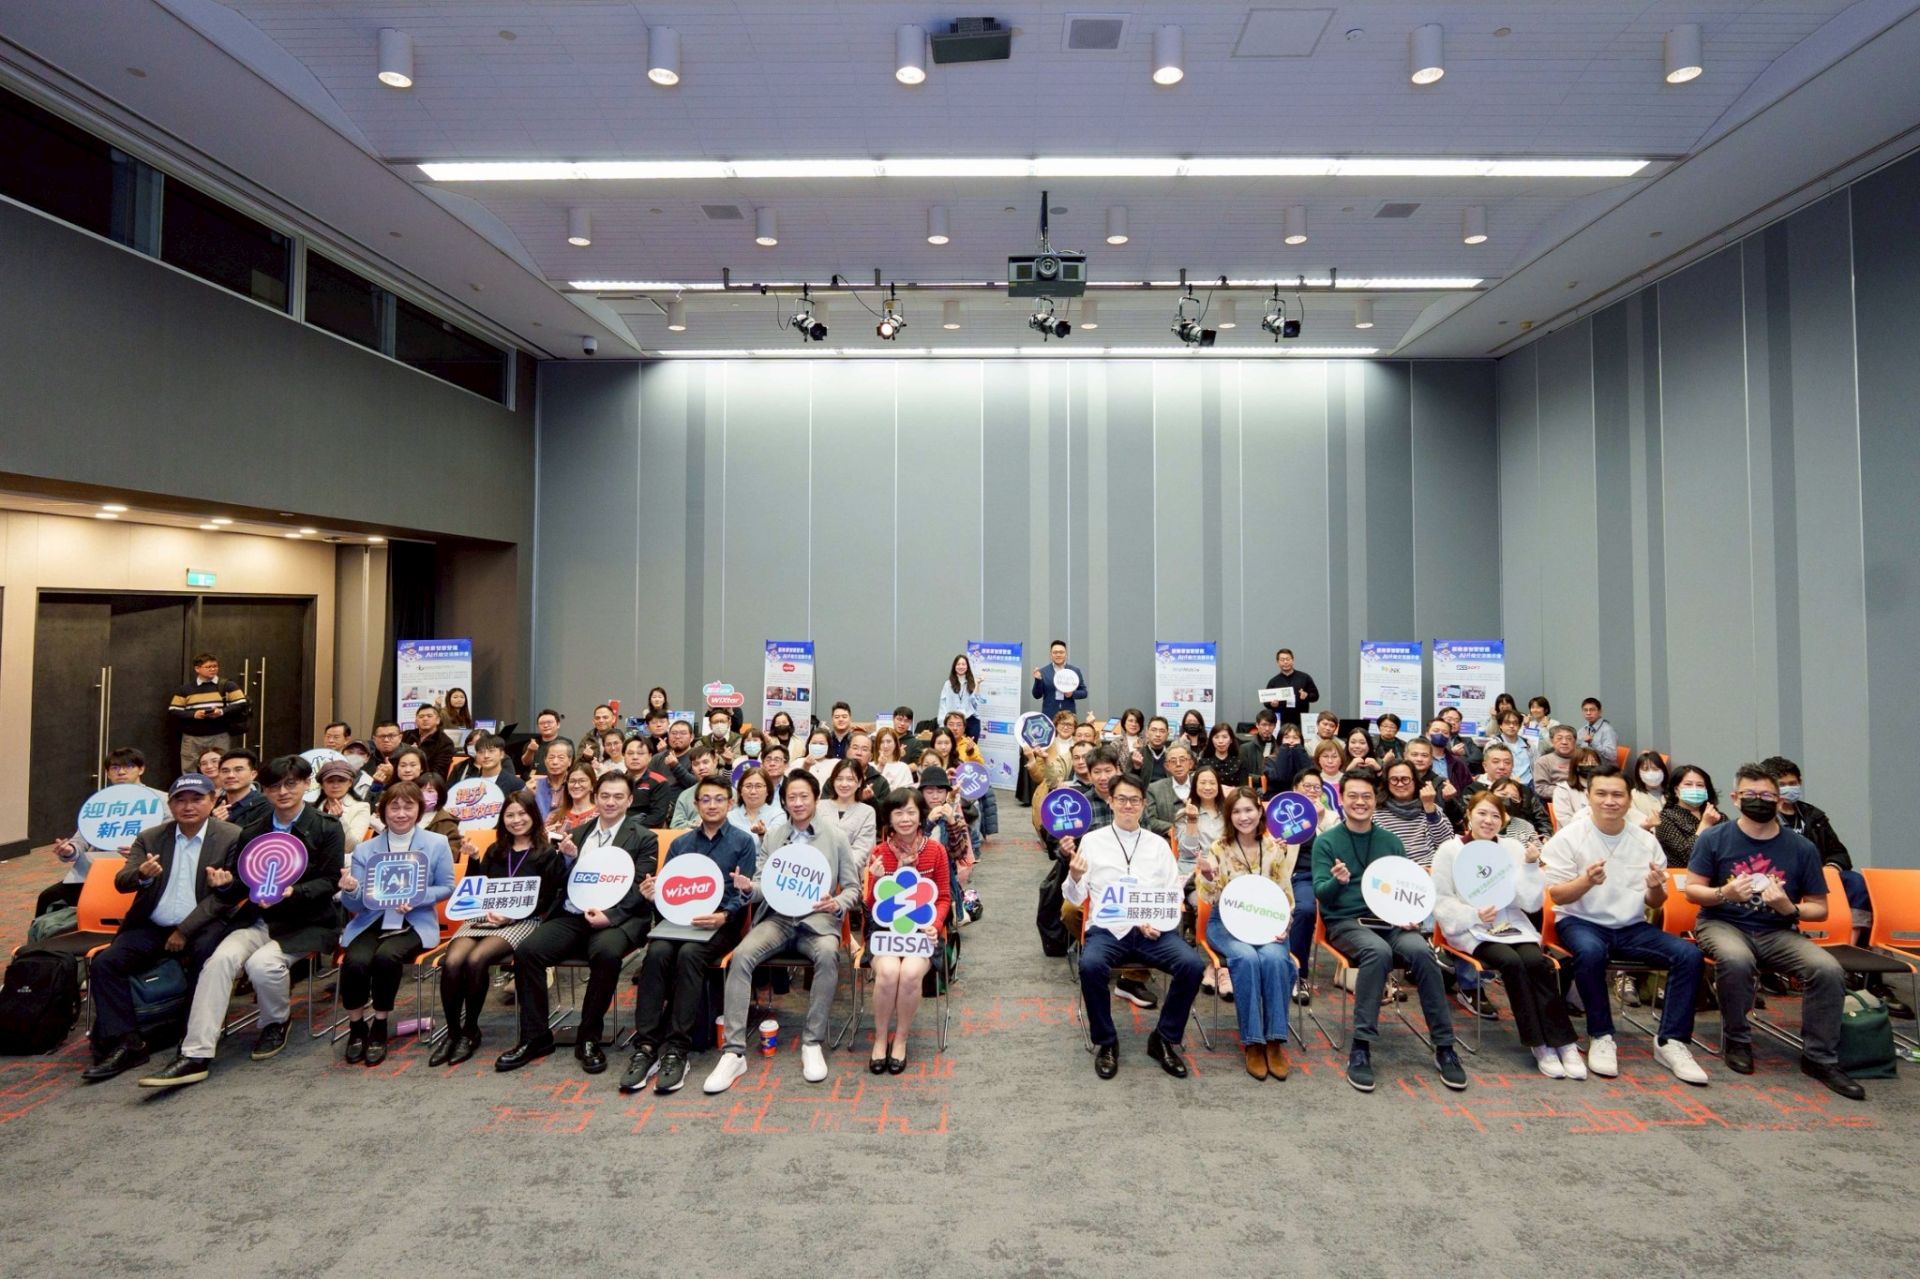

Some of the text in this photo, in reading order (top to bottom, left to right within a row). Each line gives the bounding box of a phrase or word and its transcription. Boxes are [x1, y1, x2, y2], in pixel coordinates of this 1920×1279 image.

[82, 798, 161, 819] 迎向AI
[97, 820, 143, 838] 新局
[387, 873, 405, 886] AI
[771, 858, 825, 885] Mobile
[457, 878, 483, 896] AI
[486, 880, 537, 894] 百工百業
[666, 882, 712, 898] wixtar
[776, 874, 820, 901] Wish
[1101, 886, 1124, 904] AI
[482, 895, 535, 910] 服務列車
[1128, 892, 1179, 904] 百工百業
[1394, 887, 1426, 908] iNK
[1127, 907, 1179, 920] 服務列車
[1224, 897, 1286, 921] WIAdvance
[875, 936, 930, 953] TISSA
